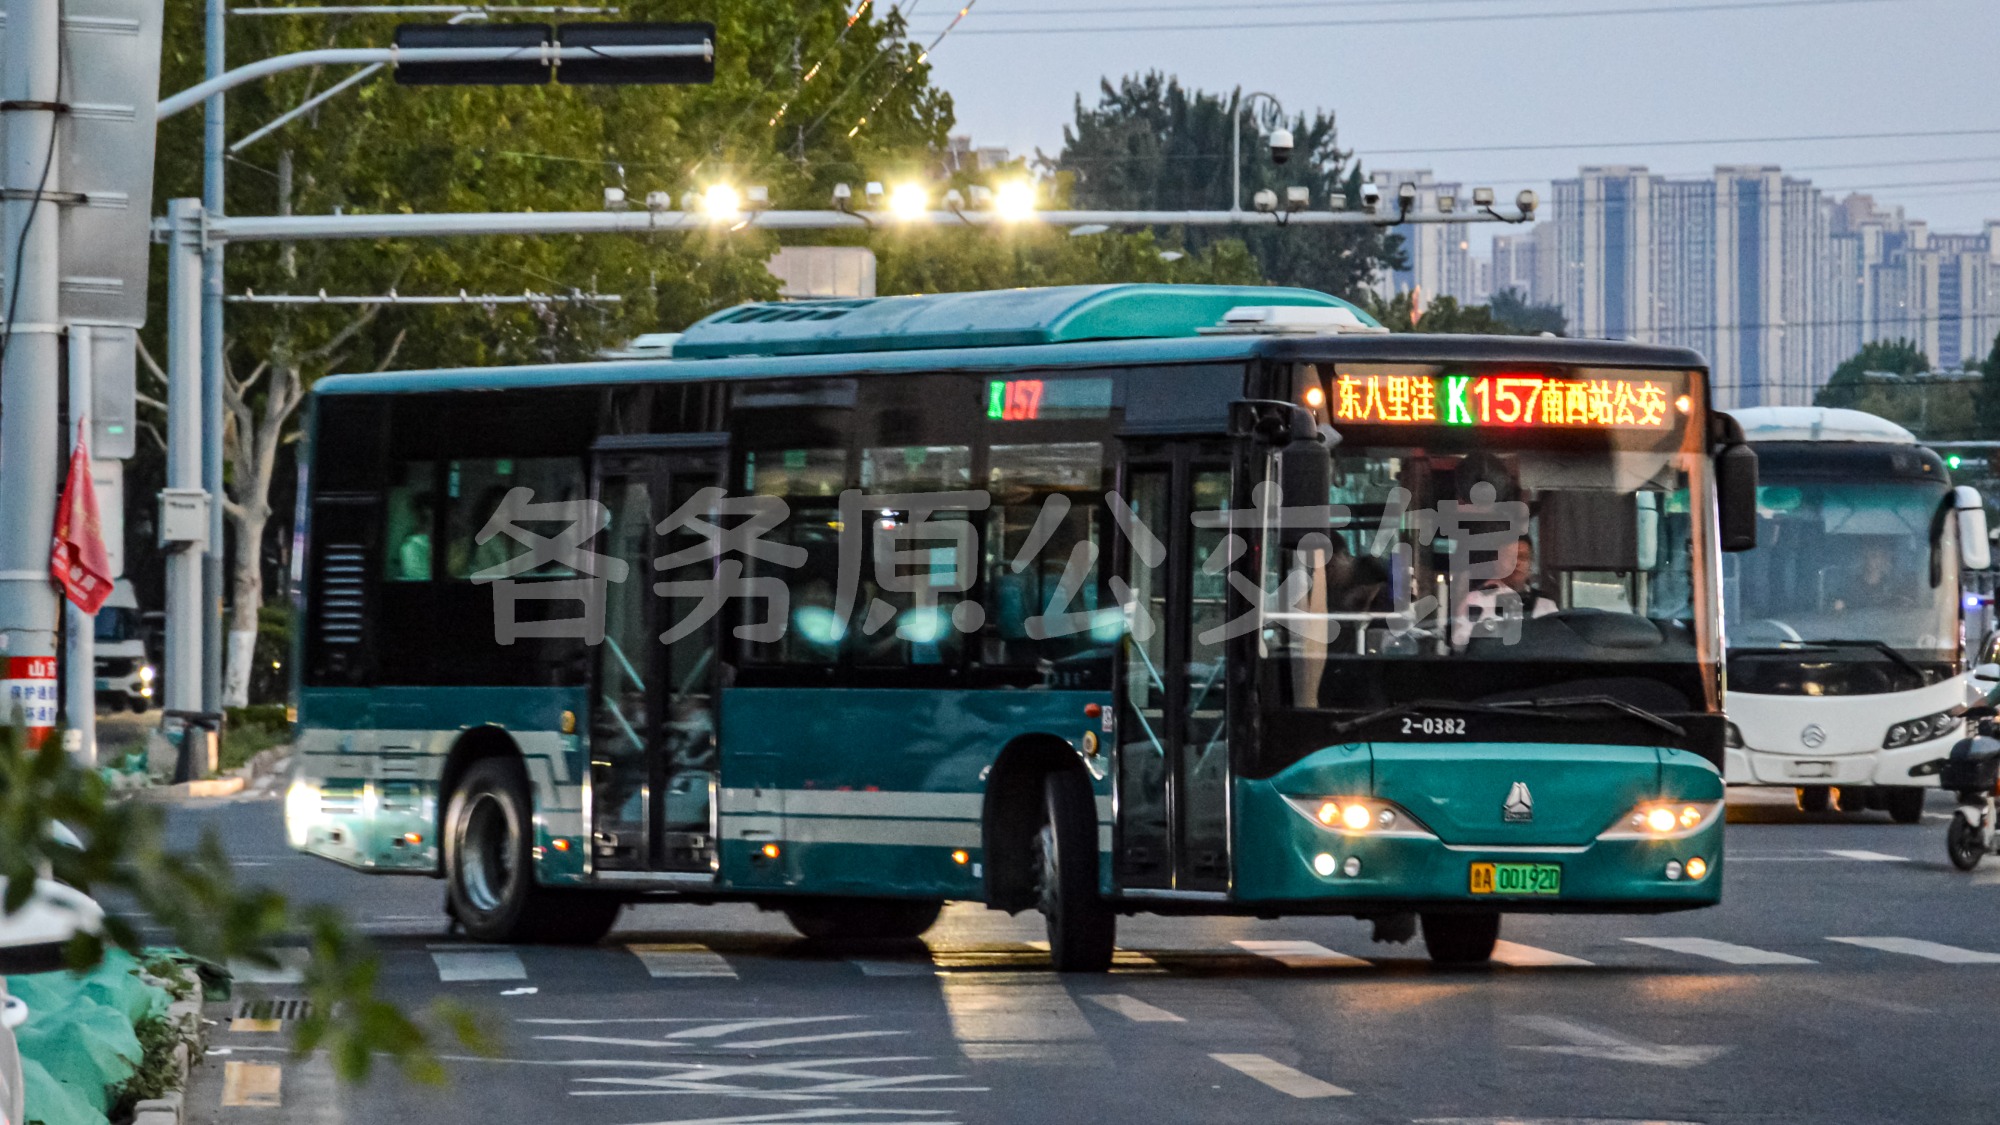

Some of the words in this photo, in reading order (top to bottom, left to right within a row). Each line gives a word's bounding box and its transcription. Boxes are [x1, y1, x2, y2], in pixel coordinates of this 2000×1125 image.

[1337, 375, 1436, 422] 东八里洼
[1447, 375, 1543, 424] K157
[1401, 718, 1466, 735] 2-0382
